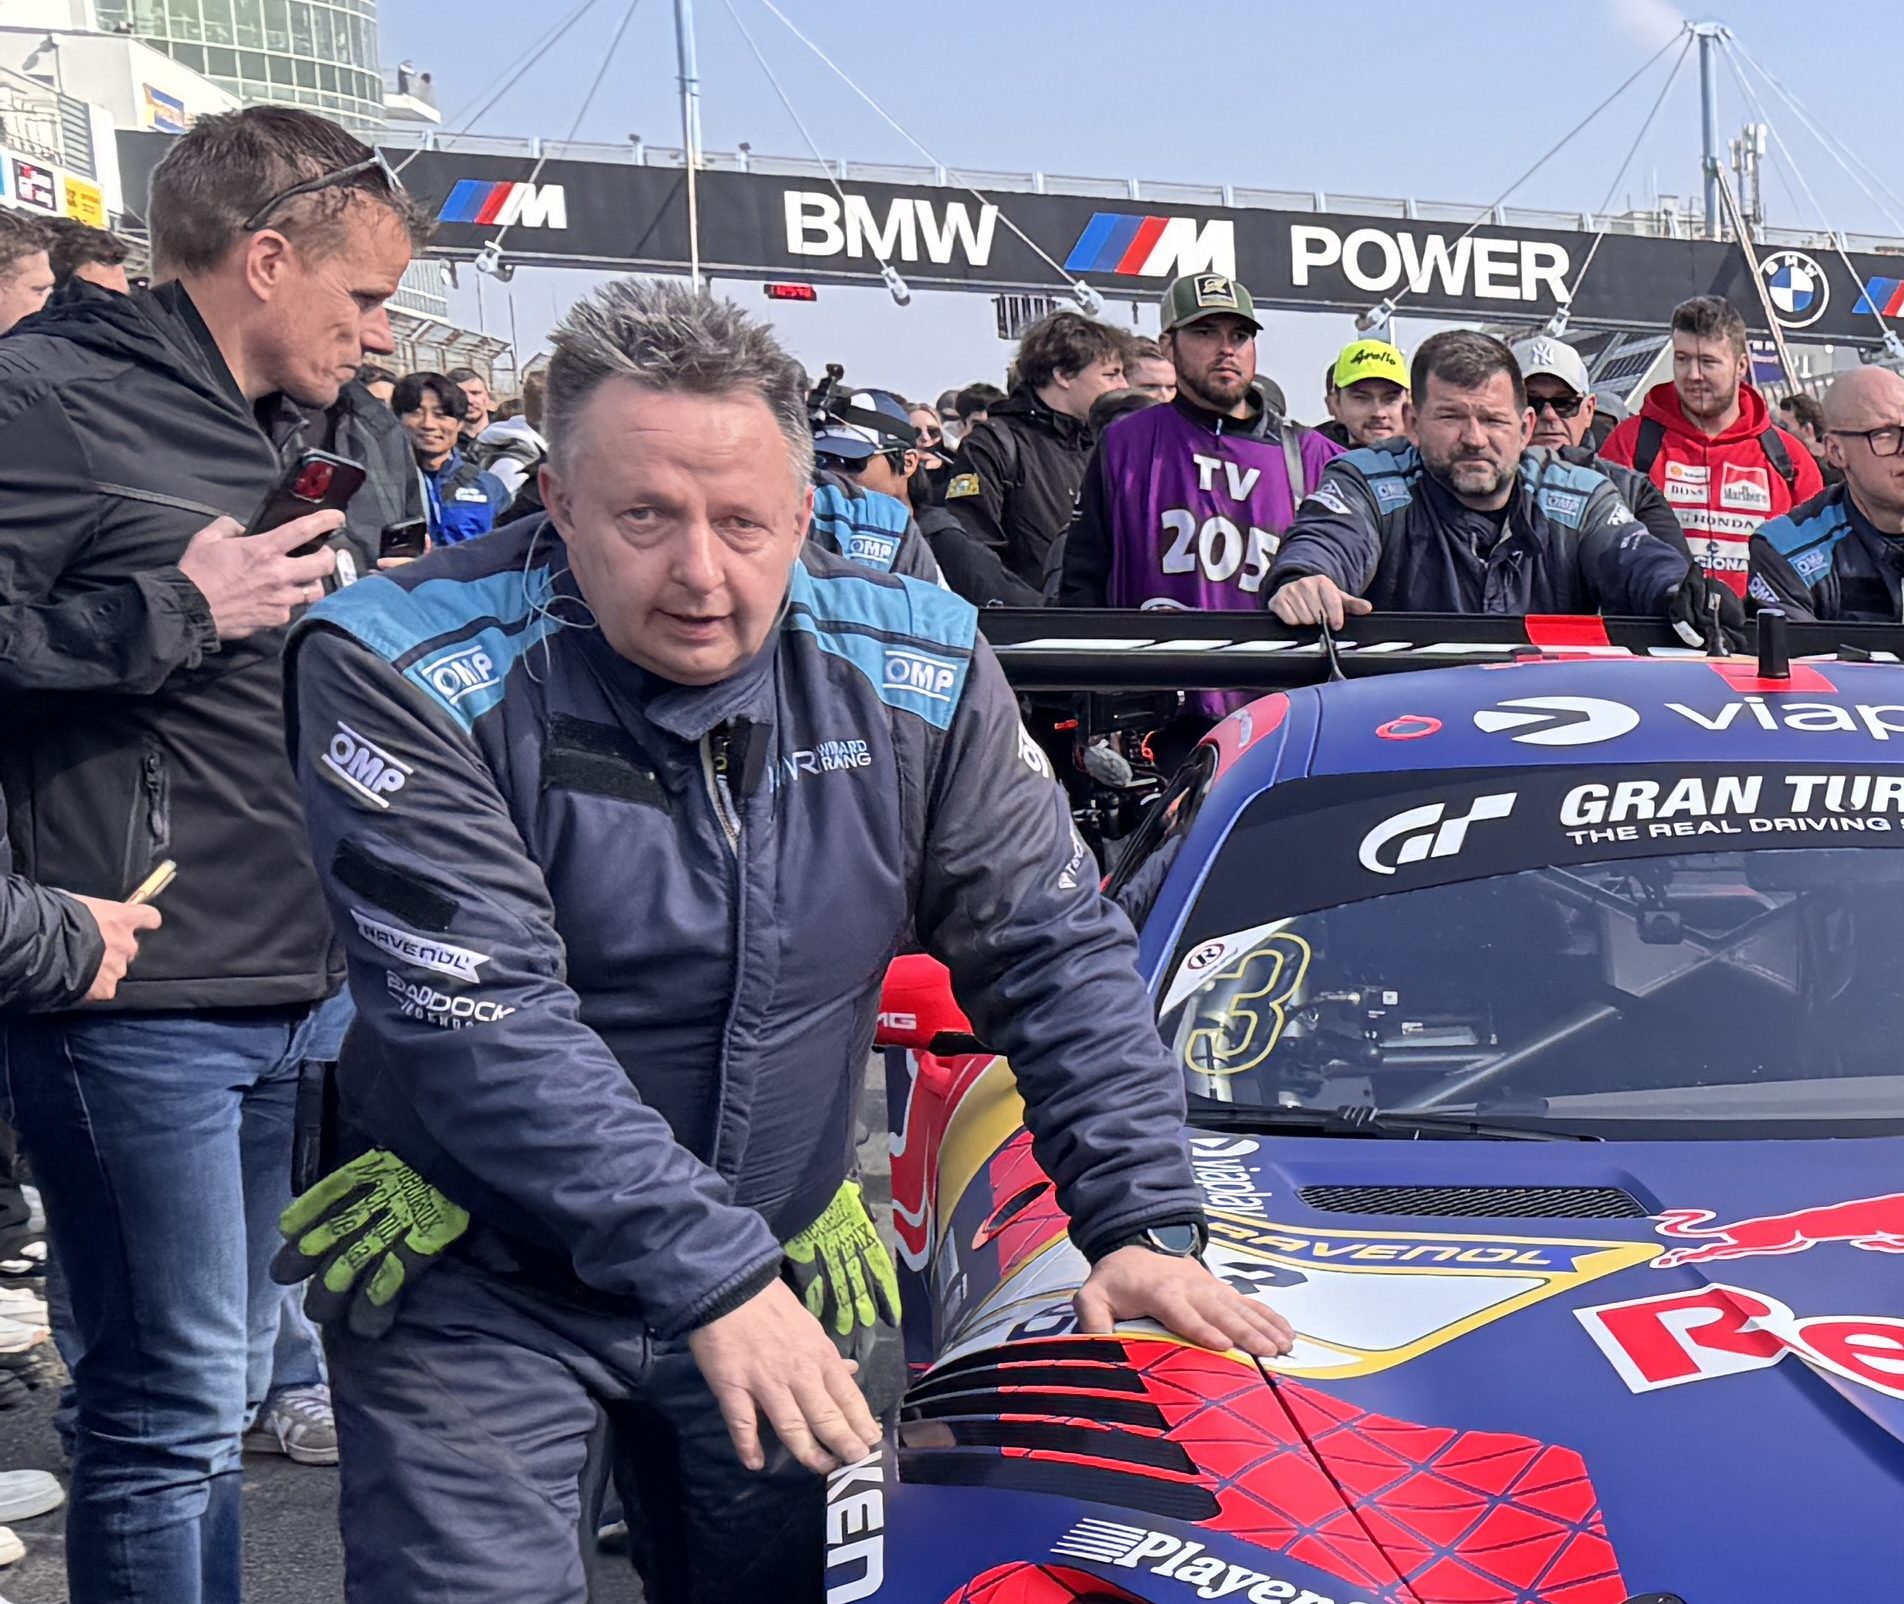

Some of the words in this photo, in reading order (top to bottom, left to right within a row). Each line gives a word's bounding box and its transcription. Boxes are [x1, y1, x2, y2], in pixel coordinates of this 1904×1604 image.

[785, 191, 998, 266] BMW
[1140, 218, 1236, 282] M
[1290, 225, 1572, 303] POWER
[1193, 453, 1261, 501] TV
[851, 540, 892, 558] OMP
[1161, 509, 1280, 593] 205
[432, 652, 493, 698] OMP
[885, 658, 955, 693] OMP
[331, 733, 406, 794] OMP
[1559, 776, 1761, 827] GRAN
[1566, 826, 1639, 845] THE
[1648, 819, 1742, 838] REAL
[1748, 817, 1892, 832] DRIVING
[1192, 1159, 1272, 1219] viaplay
